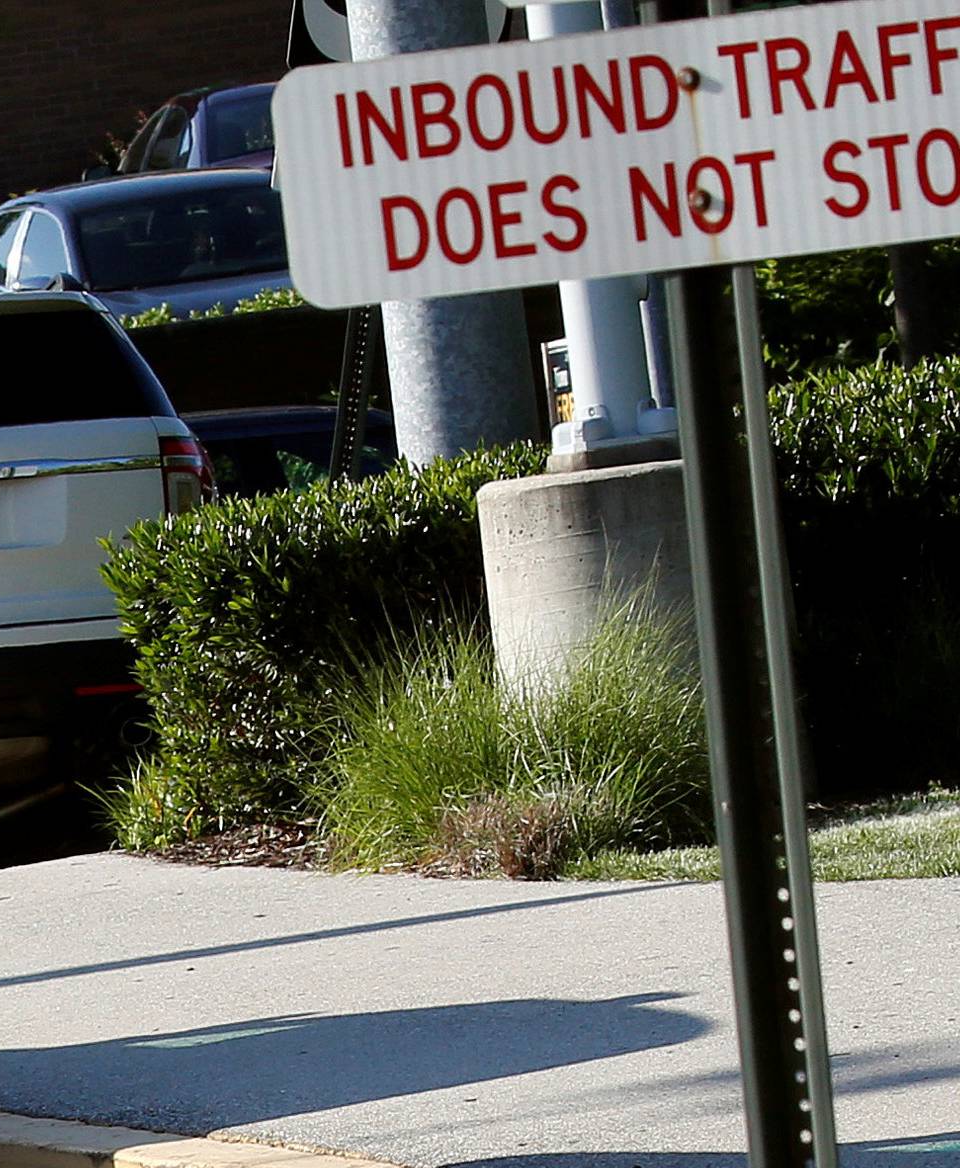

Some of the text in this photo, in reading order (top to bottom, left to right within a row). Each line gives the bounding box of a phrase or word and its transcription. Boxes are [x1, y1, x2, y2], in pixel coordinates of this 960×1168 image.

[335, 16, 960, 168] INBOUND TRAFF
[380, 128, 960, 272] DOES NOT STO
